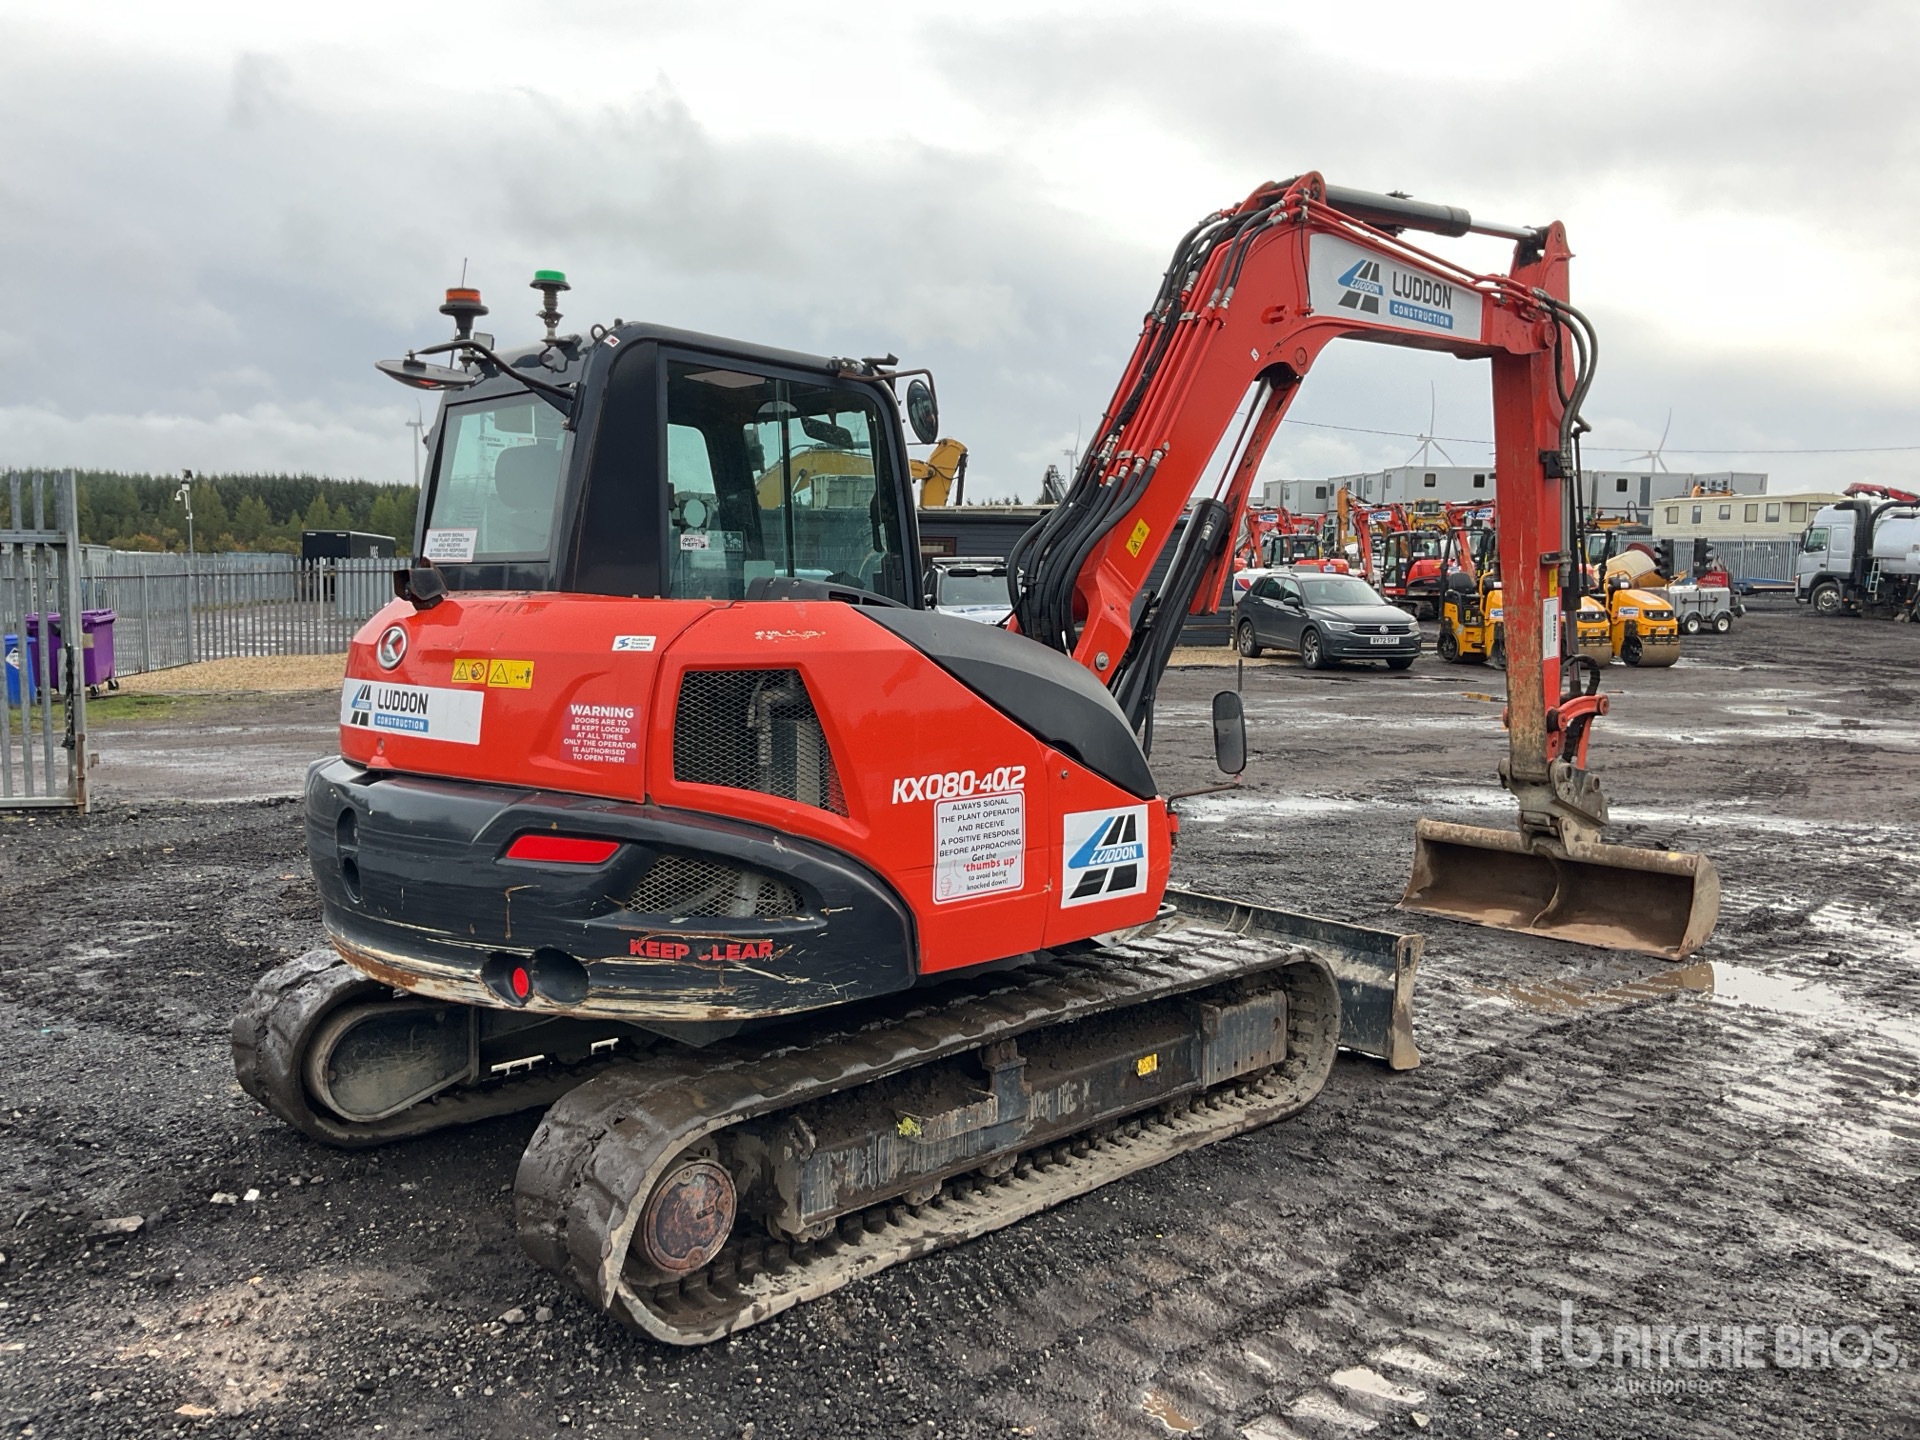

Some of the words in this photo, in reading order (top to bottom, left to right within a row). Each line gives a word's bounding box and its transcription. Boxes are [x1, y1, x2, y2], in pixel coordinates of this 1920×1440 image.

[1350, 279, 1380, 294] LUDDON
[1393, 271, 1452, 310] LUDDON
[1393, 304, 1450, 326] CONSTRUCTION
[377, 688, 429, 715] LUDDON
[570, 704, 634, 719] WARNING
[377, 715, 424, 730] CONSTRUCTION
[601, 718, 616, 726] ARE
[601, 726, 630, 734] LOCKED
[602, 733, 623, 741] TIMES
[598, 740, 637, 749] OPERATOR
[580, 747, 626, 756] AUTHORISED
[584, 754, 603, 762] OPEN
[952, 801, 982, 811] ALWAYS
[983, 798, 1009, 807] SIGNAL
[957, 812, 981, 821] PLANT
[983, 807, 1020, 818] OPERATOR
[957, 824, 973, 832] AND
[975, 820, 1005, 830] RECEIVE
[948, 834, 981, 844] POSITIVE
[983, 828, 1020, 839] RESPONSE
[939, 847, 969, 857] BEFORE
[971, 839, 1021, 852] APPROACHING
[971, 853, 984, 862] Get
[986, 852, 997, 860] the
[1088, 845, 1137, 865] LUDDON
[976, 872, 991, 880] avoid
[966, 881, 990, 891] knocked
[991, 878, 1008, 887] down!
[629, 938, 690, 960] KEEP
